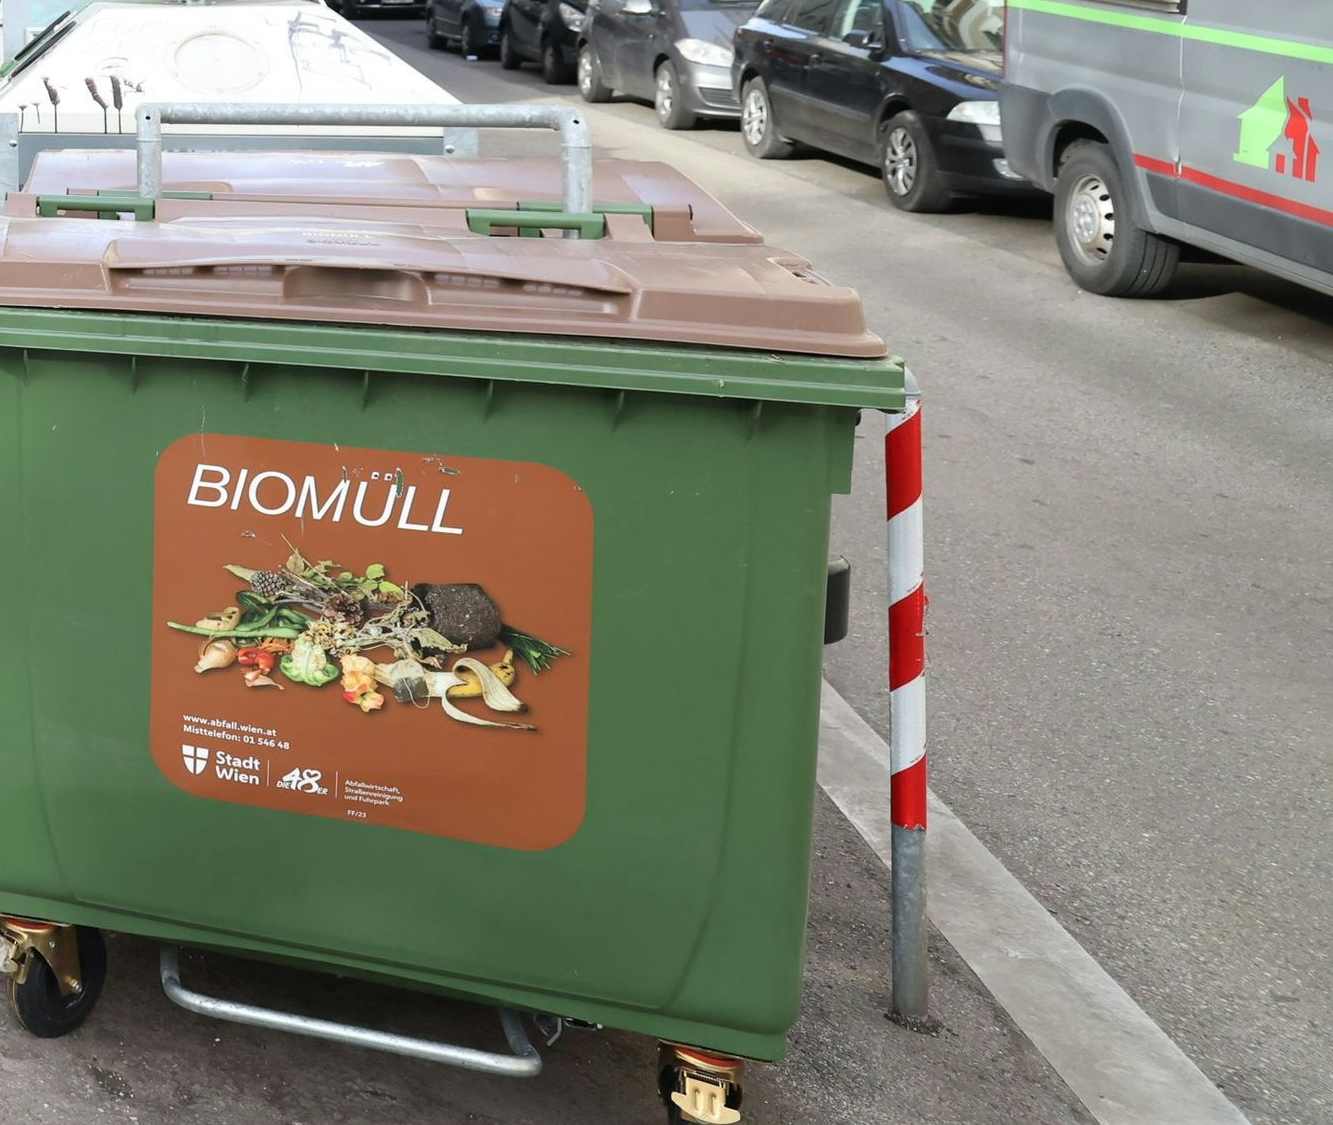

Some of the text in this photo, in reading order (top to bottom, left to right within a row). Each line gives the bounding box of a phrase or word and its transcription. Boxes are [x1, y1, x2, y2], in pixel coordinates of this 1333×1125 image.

[187, 463, 465, 535] BIOMÜLL
[183, 714, 277, 737] www.abfall.wien.at
[183, 725, 290, 750] Misttelefon: 01 546 48
[216, 751, 261, 771] Stadt
[215, 765, 260, 785] Wien
[345, 779, 401, 794] Abfallwirtschaft,
[344, 793, 390, 806] und Fuhrpark
